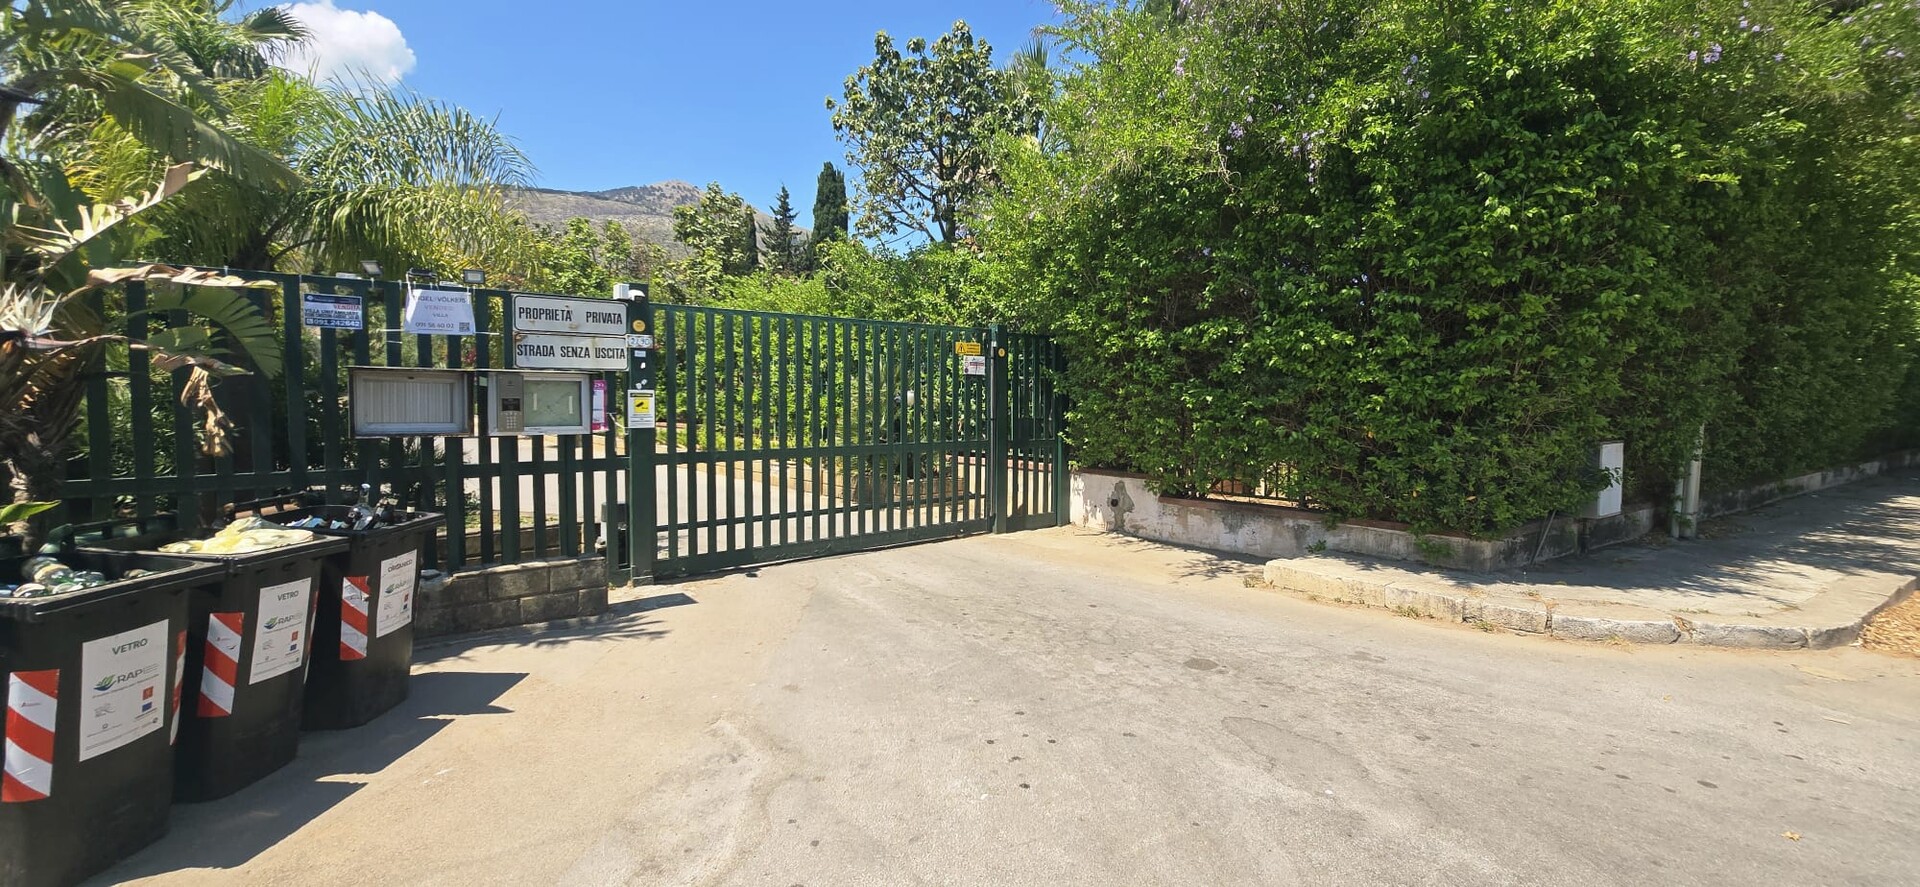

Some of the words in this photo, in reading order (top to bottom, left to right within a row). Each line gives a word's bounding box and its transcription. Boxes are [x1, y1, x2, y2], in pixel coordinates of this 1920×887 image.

[585, 311, 623, 325] PRIVATA
[516, 344, 555, 357] STRADA
[560, 345, 591, 359] SENZA
[594, 347, 626, 360] USCITA
[277, 590, 300, 601] VETRO
[278, 615, 294, 624] RAP
[112, 638, 148, 656] VETRO
[116, 668, 144, 684] RAP
